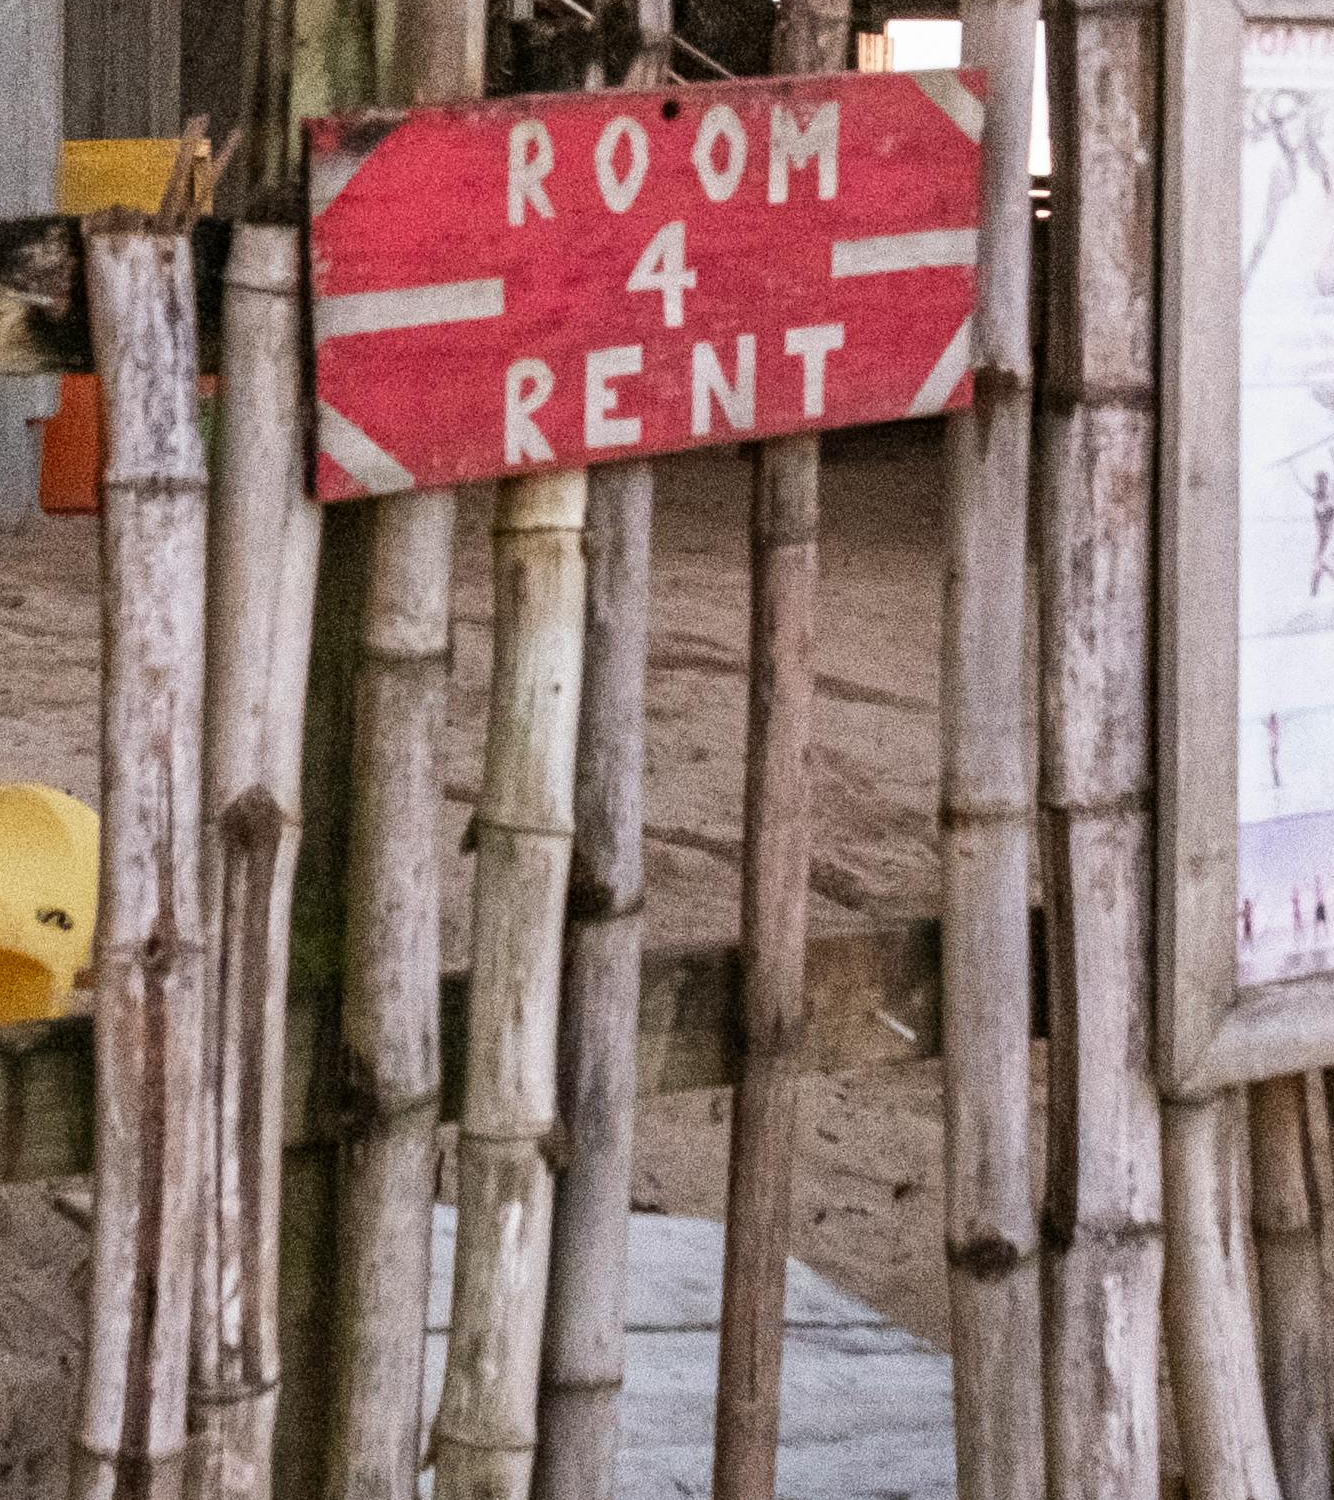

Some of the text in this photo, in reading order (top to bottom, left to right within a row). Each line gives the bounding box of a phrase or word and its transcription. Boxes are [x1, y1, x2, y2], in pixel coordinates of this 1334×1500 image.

[507, 101, 840, 226] ROOM
[627, 221, 697, 327] 4
[504, 323, 844, 466] RENT
